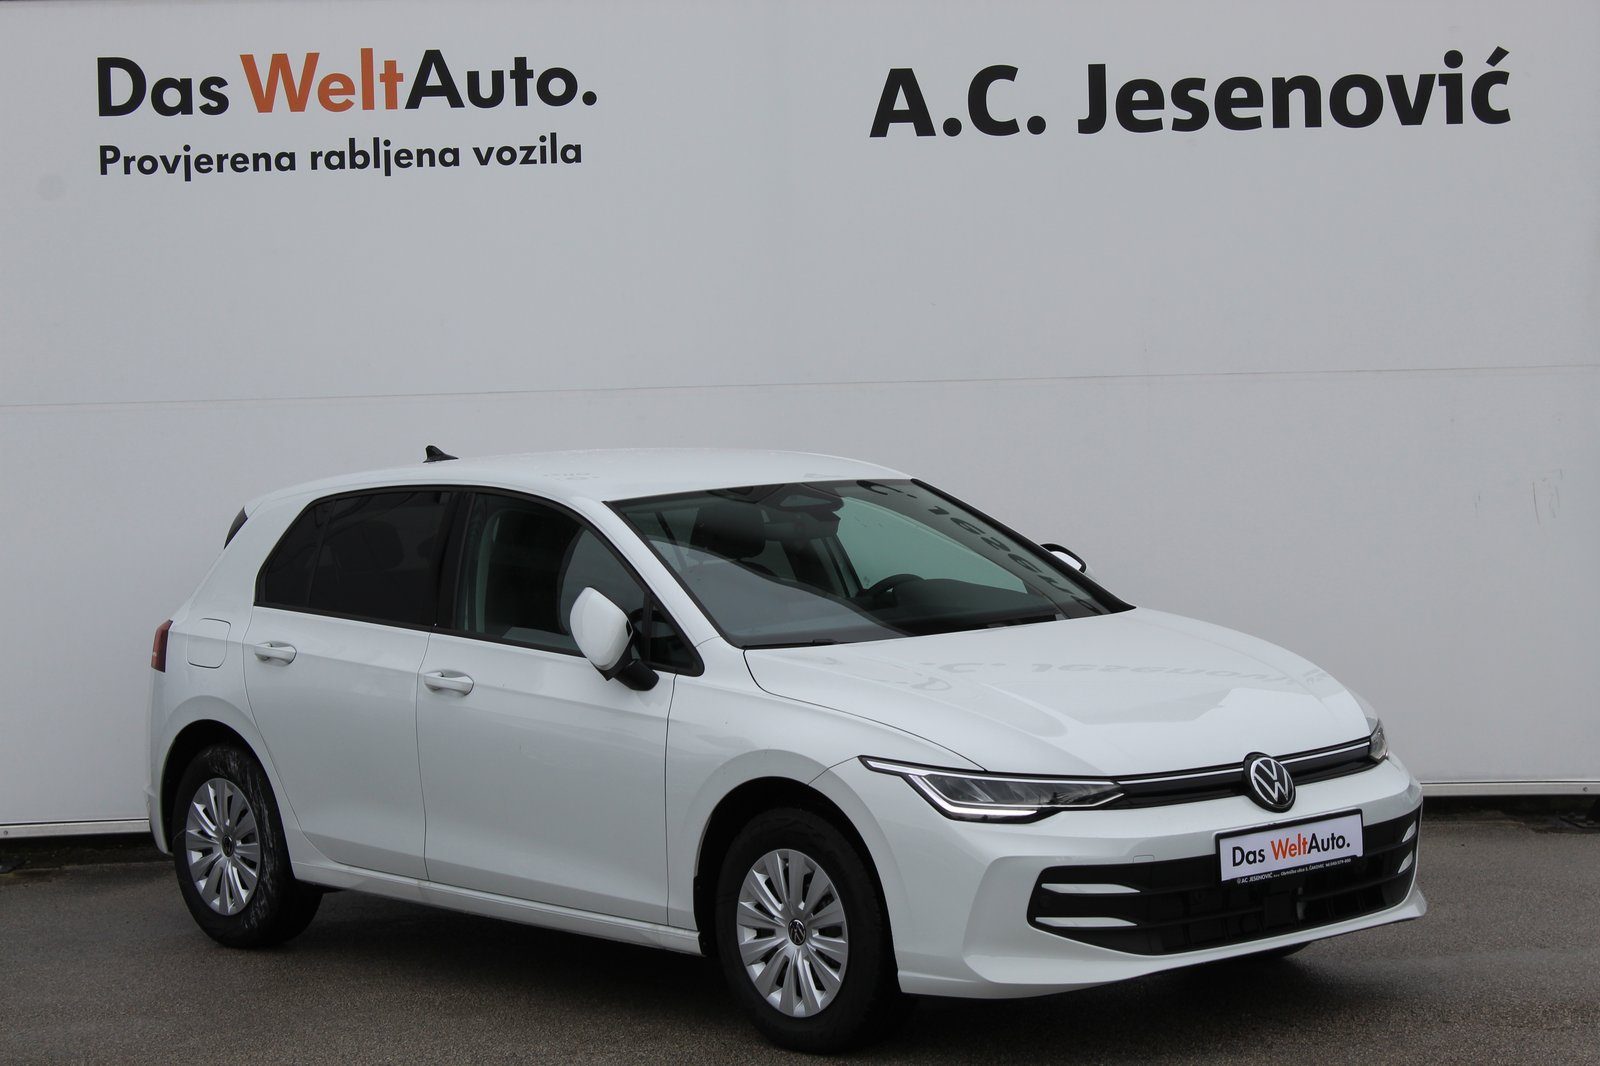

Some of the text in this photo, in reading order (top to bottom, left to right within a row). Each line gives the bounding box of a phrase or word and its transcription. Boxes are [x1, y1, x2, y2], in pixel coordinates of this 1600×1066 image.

[96, 47, 598, 117] Das WeltAuto.
[869, 45, 1512, 138] A.C. Jesenović
[99, 131, 583, 182] Provjerena rabljena vozila
[1232, 832, 1351, 868] Das WeltAuto.
